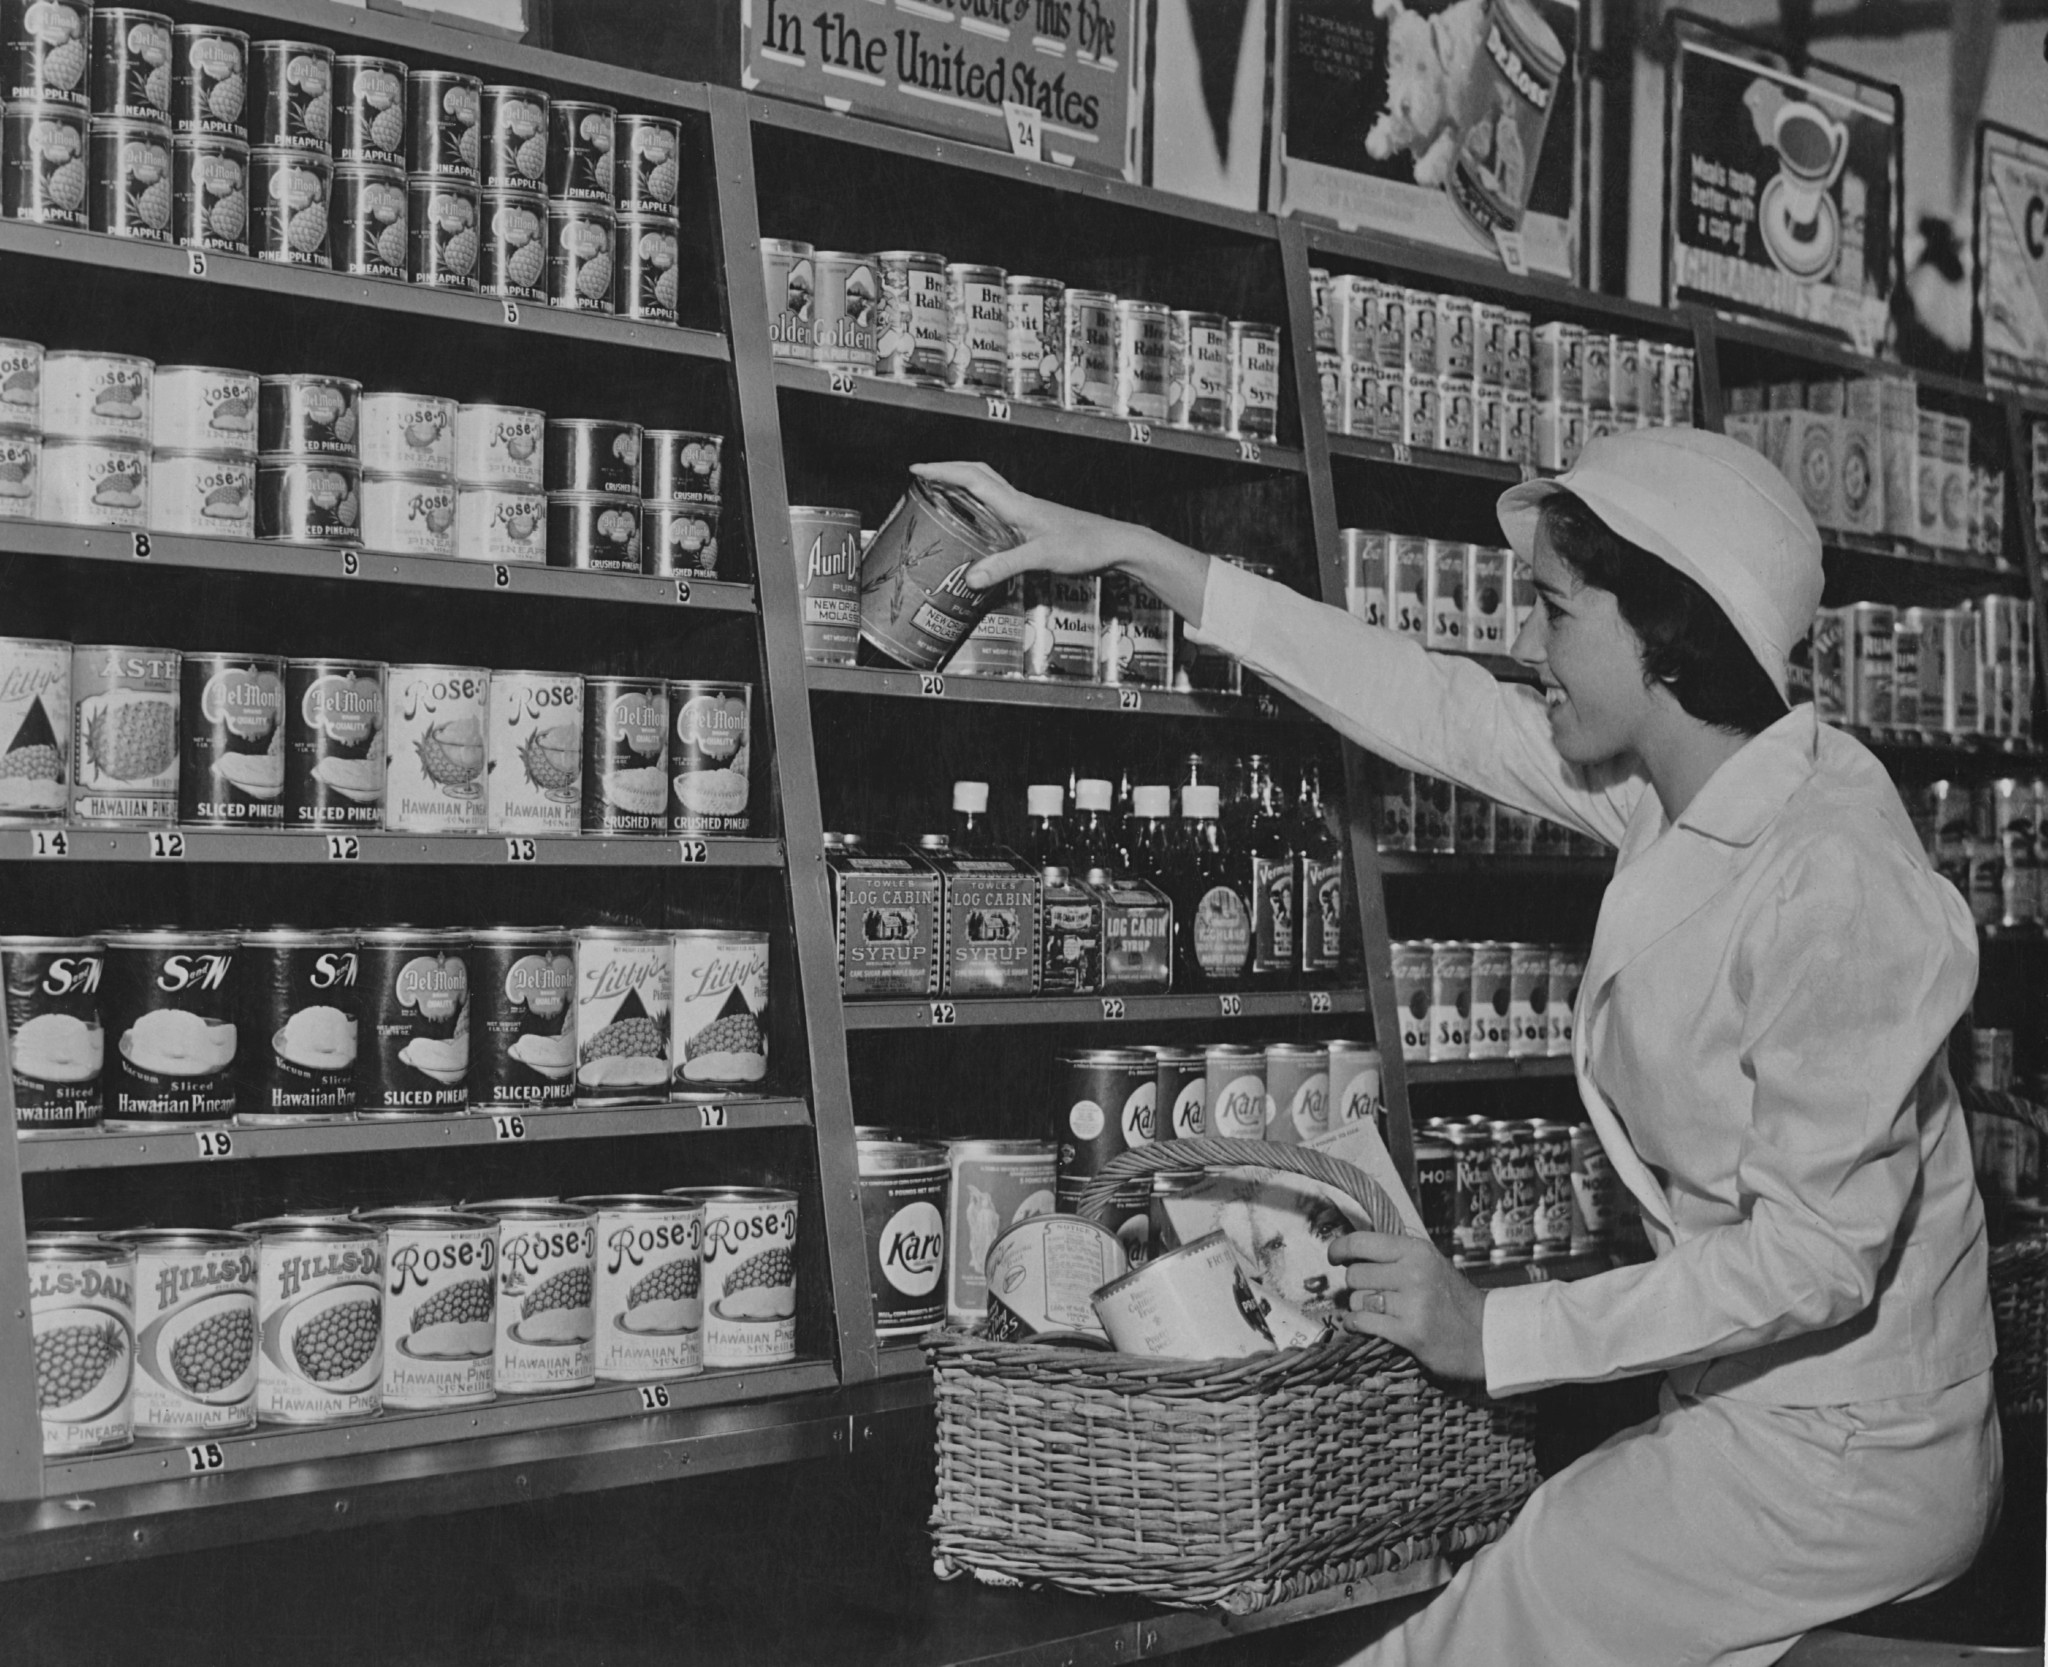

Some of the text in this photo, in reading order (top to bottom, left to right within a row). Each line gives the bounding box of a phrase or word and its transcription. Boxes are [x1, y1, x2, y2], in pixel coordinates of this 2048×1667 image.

[1078, 0, 1115, 60] type
[762, 0, 1100, 129] In the United States
[12, 87, 69, 101] PINEPPLE
[1018, 120, 1034, 147] 24
[275, 134, 326, 150] PNEAPPLE
[433, 163, 477, 178] INEAPPLE
[488, 176, 536, 190] PIEAPPLE
[569, 188, 612, 202] PINEAPPLE
[17, 207, 75, 222] PINAPPLE
[621, 200, 668, 213] PIEAPPLE
[108, 225, 162, 241] PEAPPLE
[180, 237, 234, 252] PIAPPLE
[193, 255, 205, 275] 5
[258, 250, 312, 264] PINEPPLE
[349, 263, 399, 277] PNEAPPLE
[481, 285, 530, 298] PINAPPLE
[550, 297, 600, 309] PINPPLE
[507, 305, 517, 323] 5
[770, 312, 811, 345] olden
[813, 318, 872, 350] Golden
[1133, 425, 1150, 443] 19
[136, 534, 150, 557] 8
[344, 553, 358, 575] 9
[803, 531, 848, 590] Aunt
[495, 565, 508, 586] 8
[678, 582, 690, 601] 9
[814, 599, 837, 610] NEW
[927, 609, 949, 626] NEW
[924, 677, 943, 694] 20
[1122, 692, 1138, 708] 27
[91, 799, 148, 817] HAWAIIAN
[197, 802, 246, 818] SLICED
[299, 806, 345, 820] SLICED
[402, 799, 462, 815] HAWAIIAN
[505, 802, 562, 818] HAWAIIAN
[604, 816, 649, 829] CRUSHED
[674, 817, 722, 830] CRUSHED
[38, 831, 66, 855] 14
[155, 833, 182, 857] 12
[331, 838, 359, 860] 12
[510, 840, 535, 861] 13
[684, 841, 707, 863] 12
[849, 890, 932, 905] LOG CABIN
[954, 892, 1032, 906] LOG CABIN
[1107, 918, 1128, 937] LOG
[1130, 917, 1169, 937] CABIN
[852, 946, 926, 961] SYRUP
[955, 946, 1028, 961] SYRUP
[1121, 939, 1150, 952] SYRUP
[405, 968, 467, 991] Del Monte
[514, 968, 540, 989] Del
[1104, 1001, 1124, 1018] 22
[1223, 997, 1241, 1014] 30
[1312, 995, 1331, 1010] 22
[934, 1005, 954, 1024] 42
[122, 1060, 159, 1084] Vacuum
[275, 1057, 312, 1079] Vacuum
[56, 1087, 94, 1098] Sliced
[171, 1081, 214, 1092] Sliced
[494, 1086, 541, 1100] SLICED
[118, 1093, 190, 1114] Hawaiian
[272, 1088, 336, 1108] Hawaiian
[384, 1091, 433, 1106] SLICED
[702, 1107, 725, 1126] 17
[499, 1118, 524, 1138] 16
[201, 1132, 231, 1155] 19
[1056, 1224, 1091, 1234] NOTICE
[886, 1230, 941, 1275] Karo
[708, 1331, 771, 1344] HAWAIIAN
[612, 1345, 676, 1359] HAWAIIAN
[505, 1355, 570, 1369] HAWAIIAN
[393, 1370, 461, 1384] HAWAIIAN
[272, 1396, 342, 1410] HAWAIIAN
[643, 1385, 668, 1409] 16
[150, 1408, 221, 1424] HAWAIIAN
[190, 1445, 222, 1470] 15
